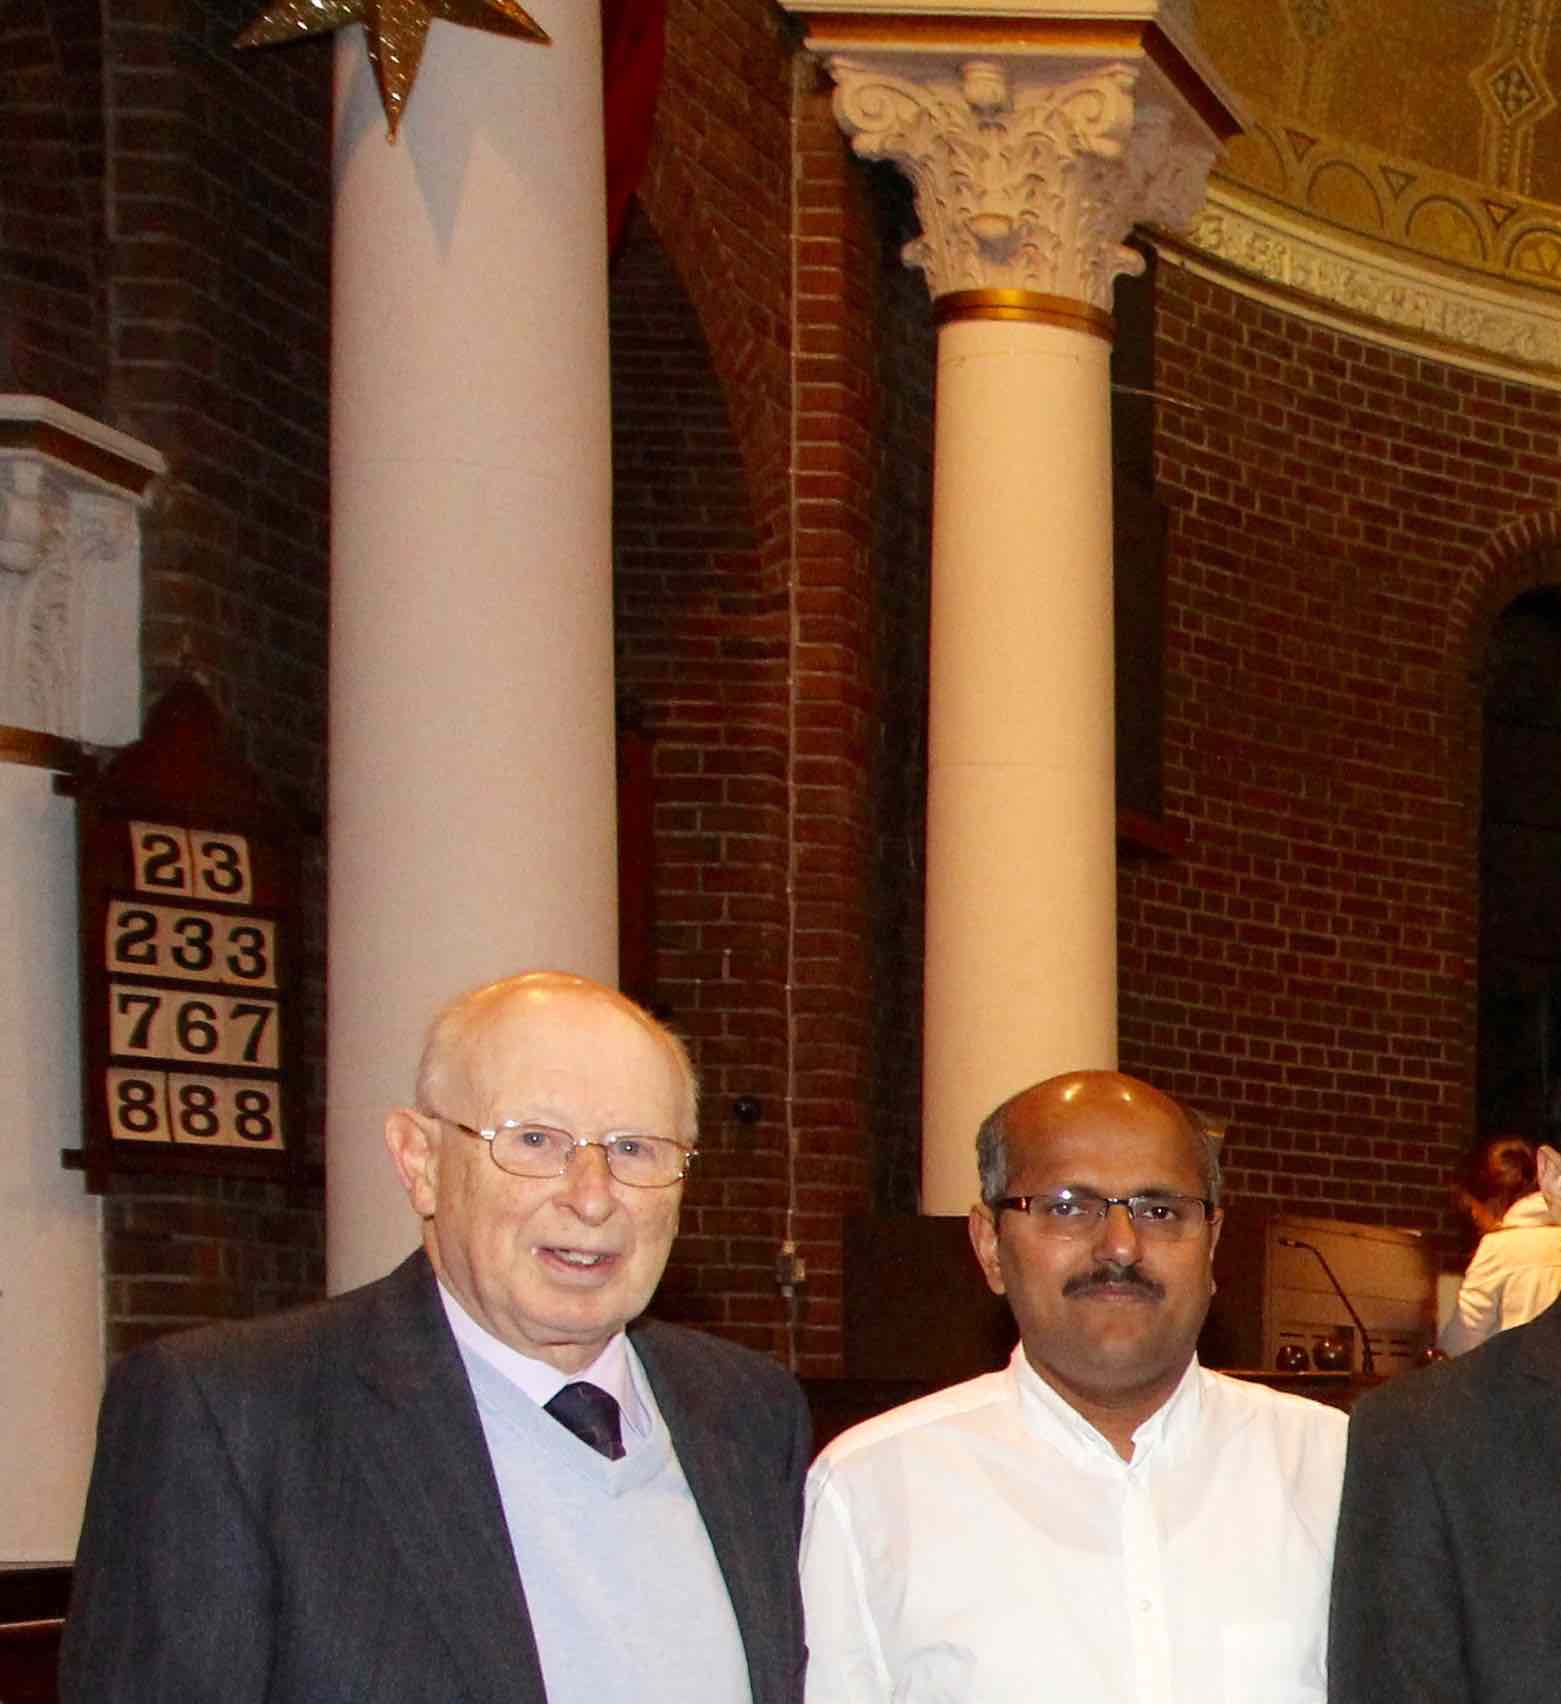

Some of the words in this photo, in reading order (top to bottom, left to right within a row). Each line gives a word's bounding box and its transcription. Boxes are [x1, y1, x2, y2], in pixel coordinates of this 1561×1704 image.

[142, 834, 244, 895] 23
[115, 910, 268, 979] 233
[117, 993, 272, 1063] 767
[118, 1079, 272, 1142] 888
